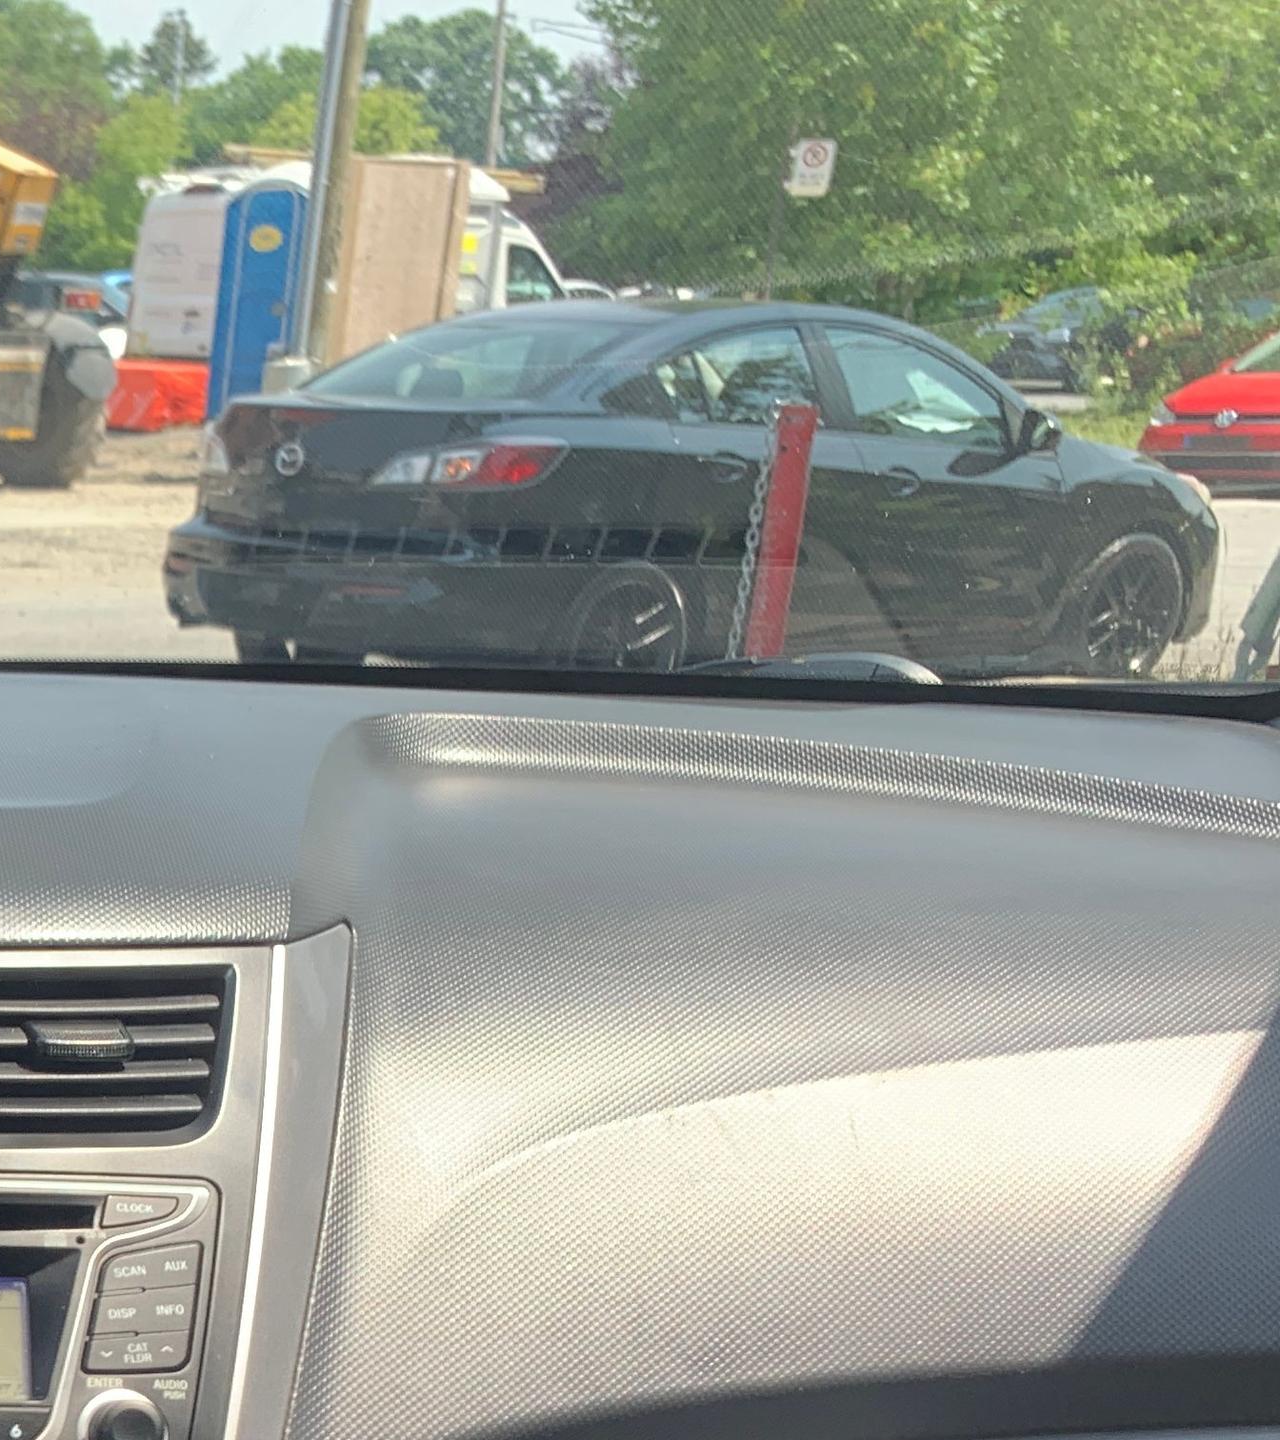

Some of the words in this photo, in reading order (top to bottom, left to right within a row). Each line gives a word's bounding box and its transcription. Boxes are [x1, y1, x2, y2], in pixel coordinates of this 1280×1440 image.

[116, 1203, 153, 1214] CLOCK
[113, 1265, 146, 1278] SCAN
[164, 1260, 188, 1272] AUX
[108, 1308, 137, 1320] DISP
[156, 1304, 185, 1316] INFO
[127, 1342, 148, 1354] CAT
[124, 1352, 152, 1364] FLDR
[86, 1378, 123, 1388] ENTER
[153, 1379, 188, 1390] AUDIO
[163, 1390, 186, 1400] PUSH
[10, 1424, 22, 1438] 6
